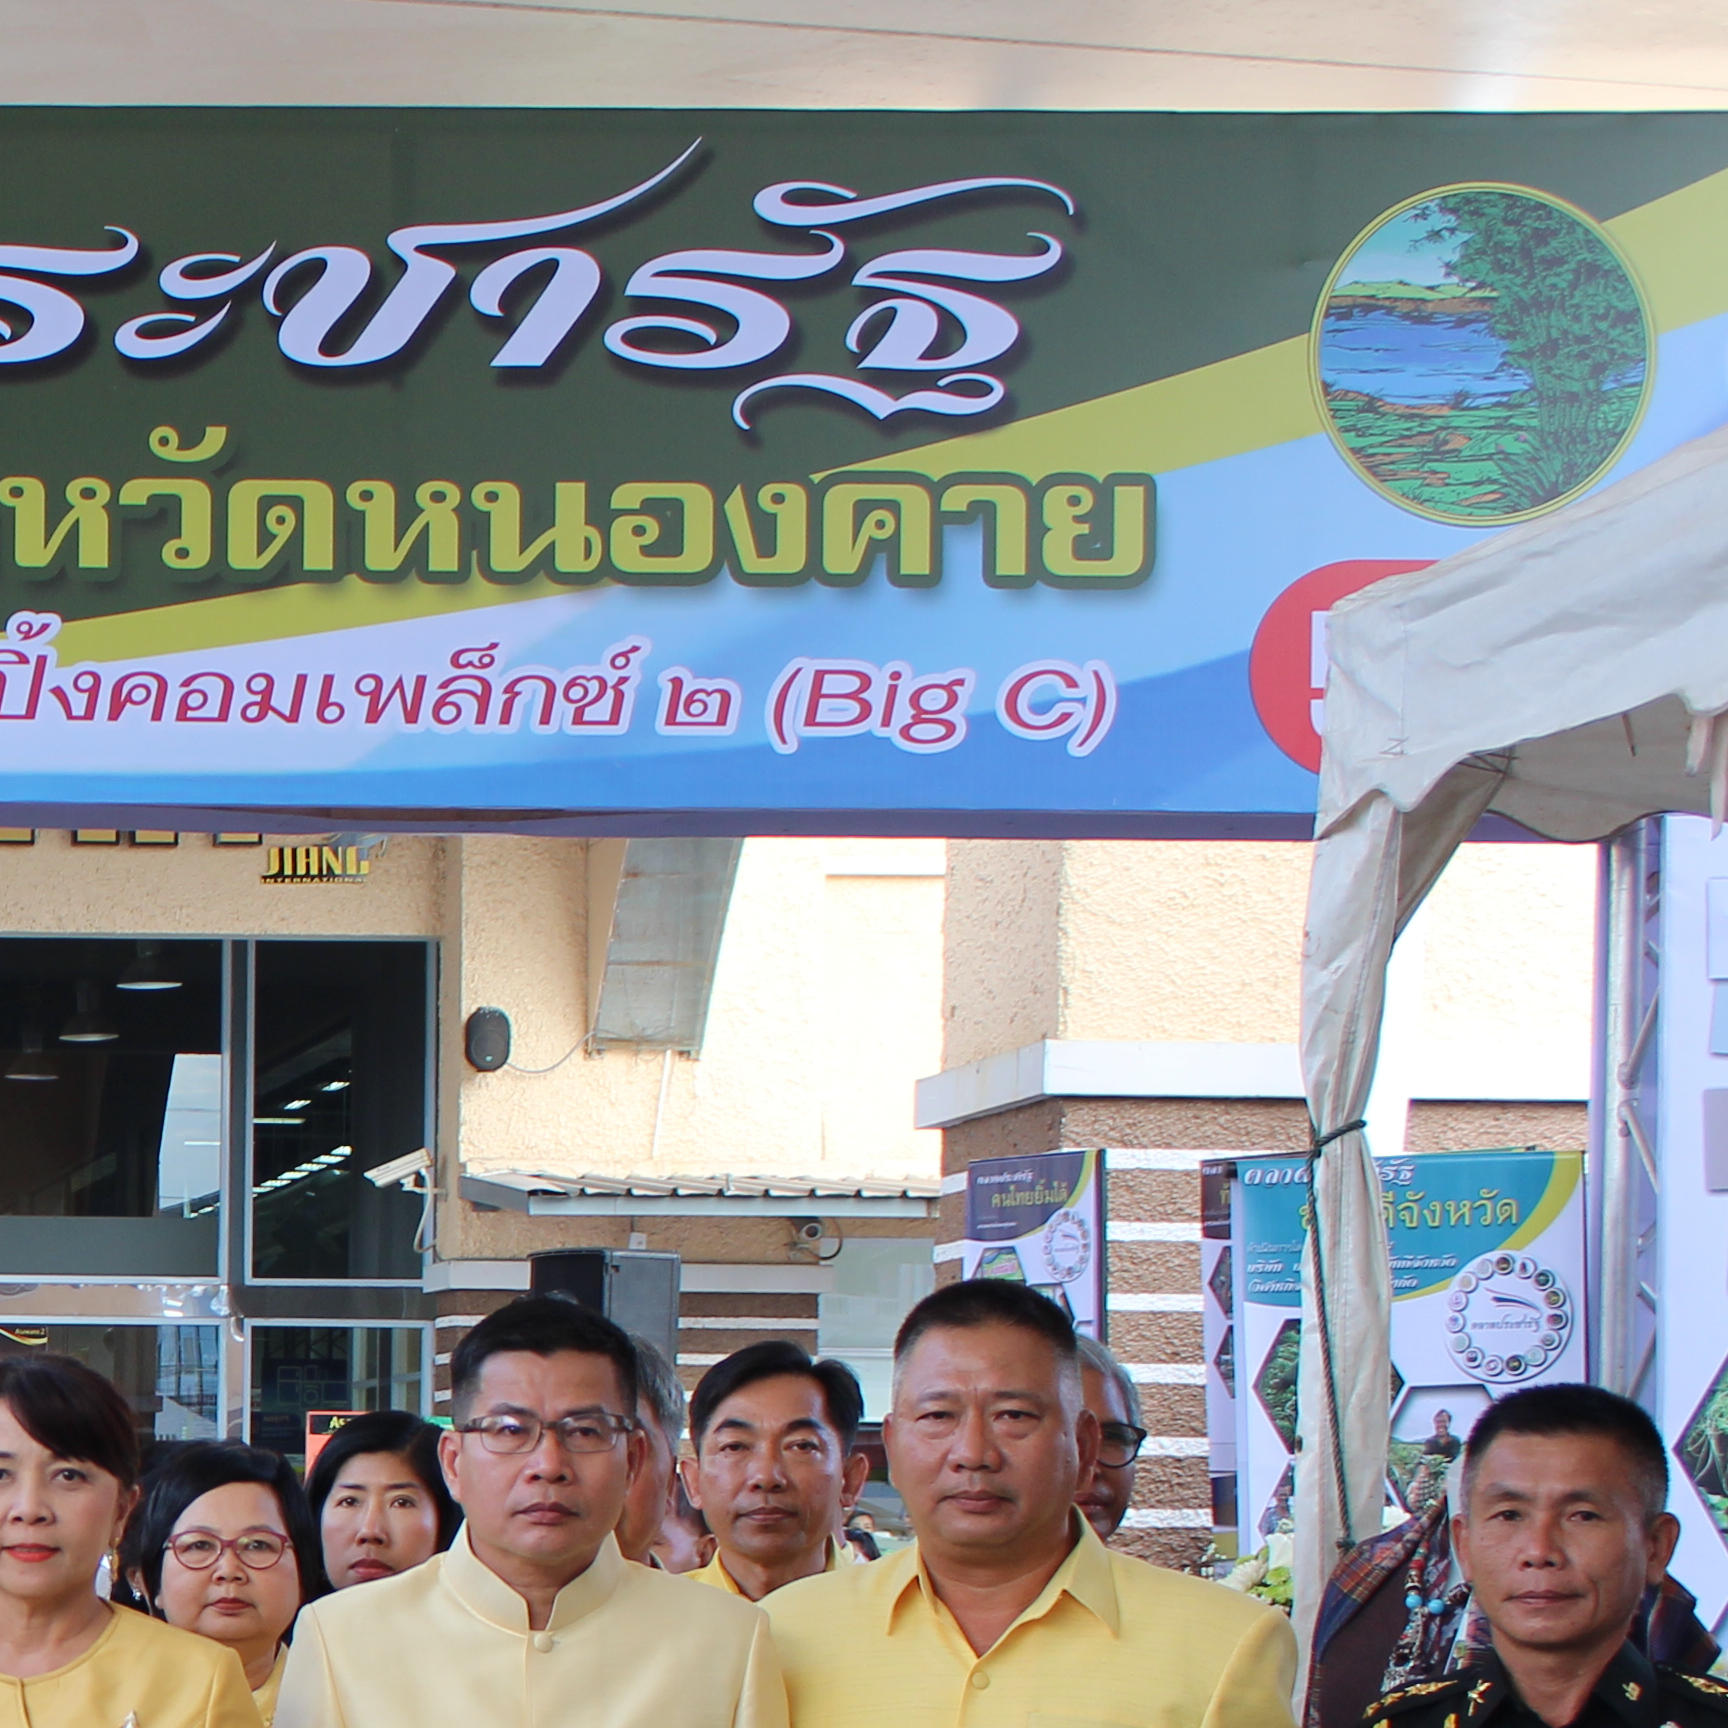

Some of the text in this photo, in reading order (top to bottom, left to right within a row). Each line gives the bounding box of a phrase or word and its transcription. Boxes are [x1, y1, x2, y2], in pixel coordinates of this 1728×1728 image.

[771, 655, 971, 754] (Big
[989, 655, 1121, 754] C)
[262, 846, 371, 876] JIANG
